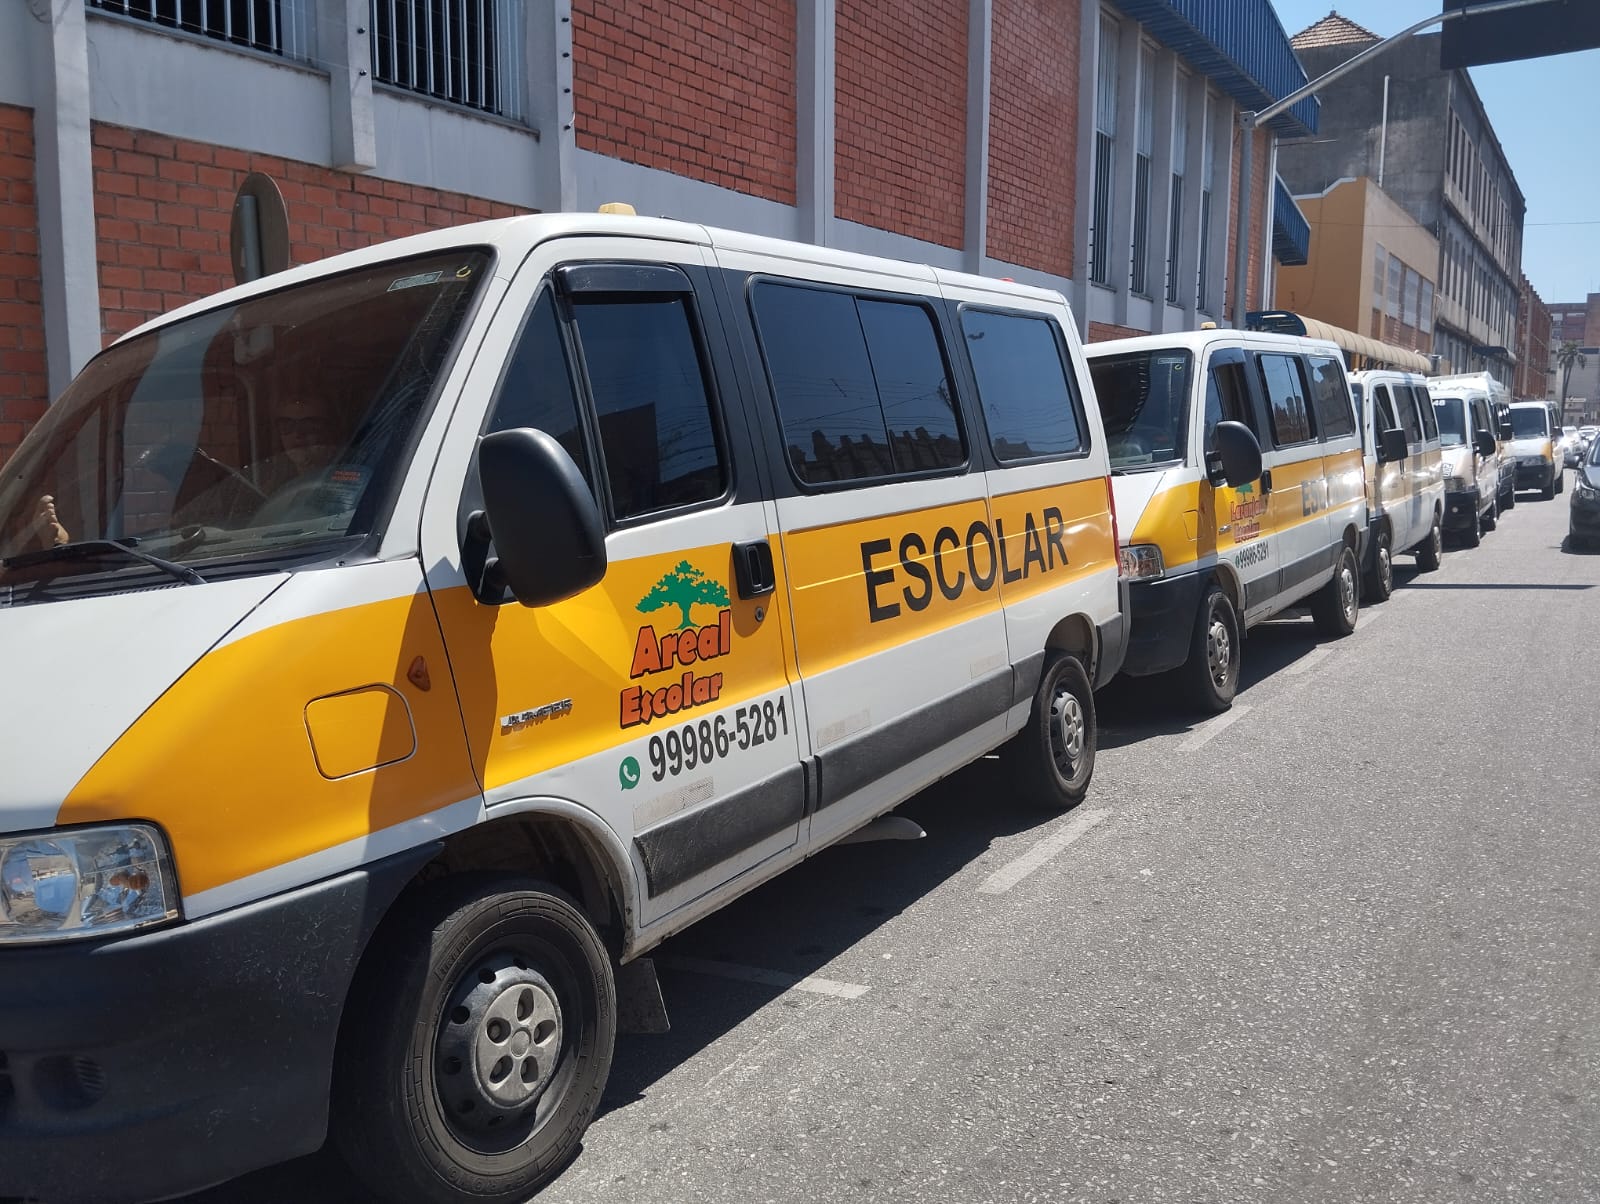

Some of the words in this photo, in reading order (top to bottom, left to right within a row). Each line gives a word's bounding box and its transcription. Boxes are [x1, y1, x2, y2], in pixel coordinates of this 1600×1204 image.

[860, 506, 1069, 623] ESCOLAR
[630, 608, 731, 679] Areal
[620, 671, 723, 729] Escolar
[649, 696, 789, 782] 99986-5281
